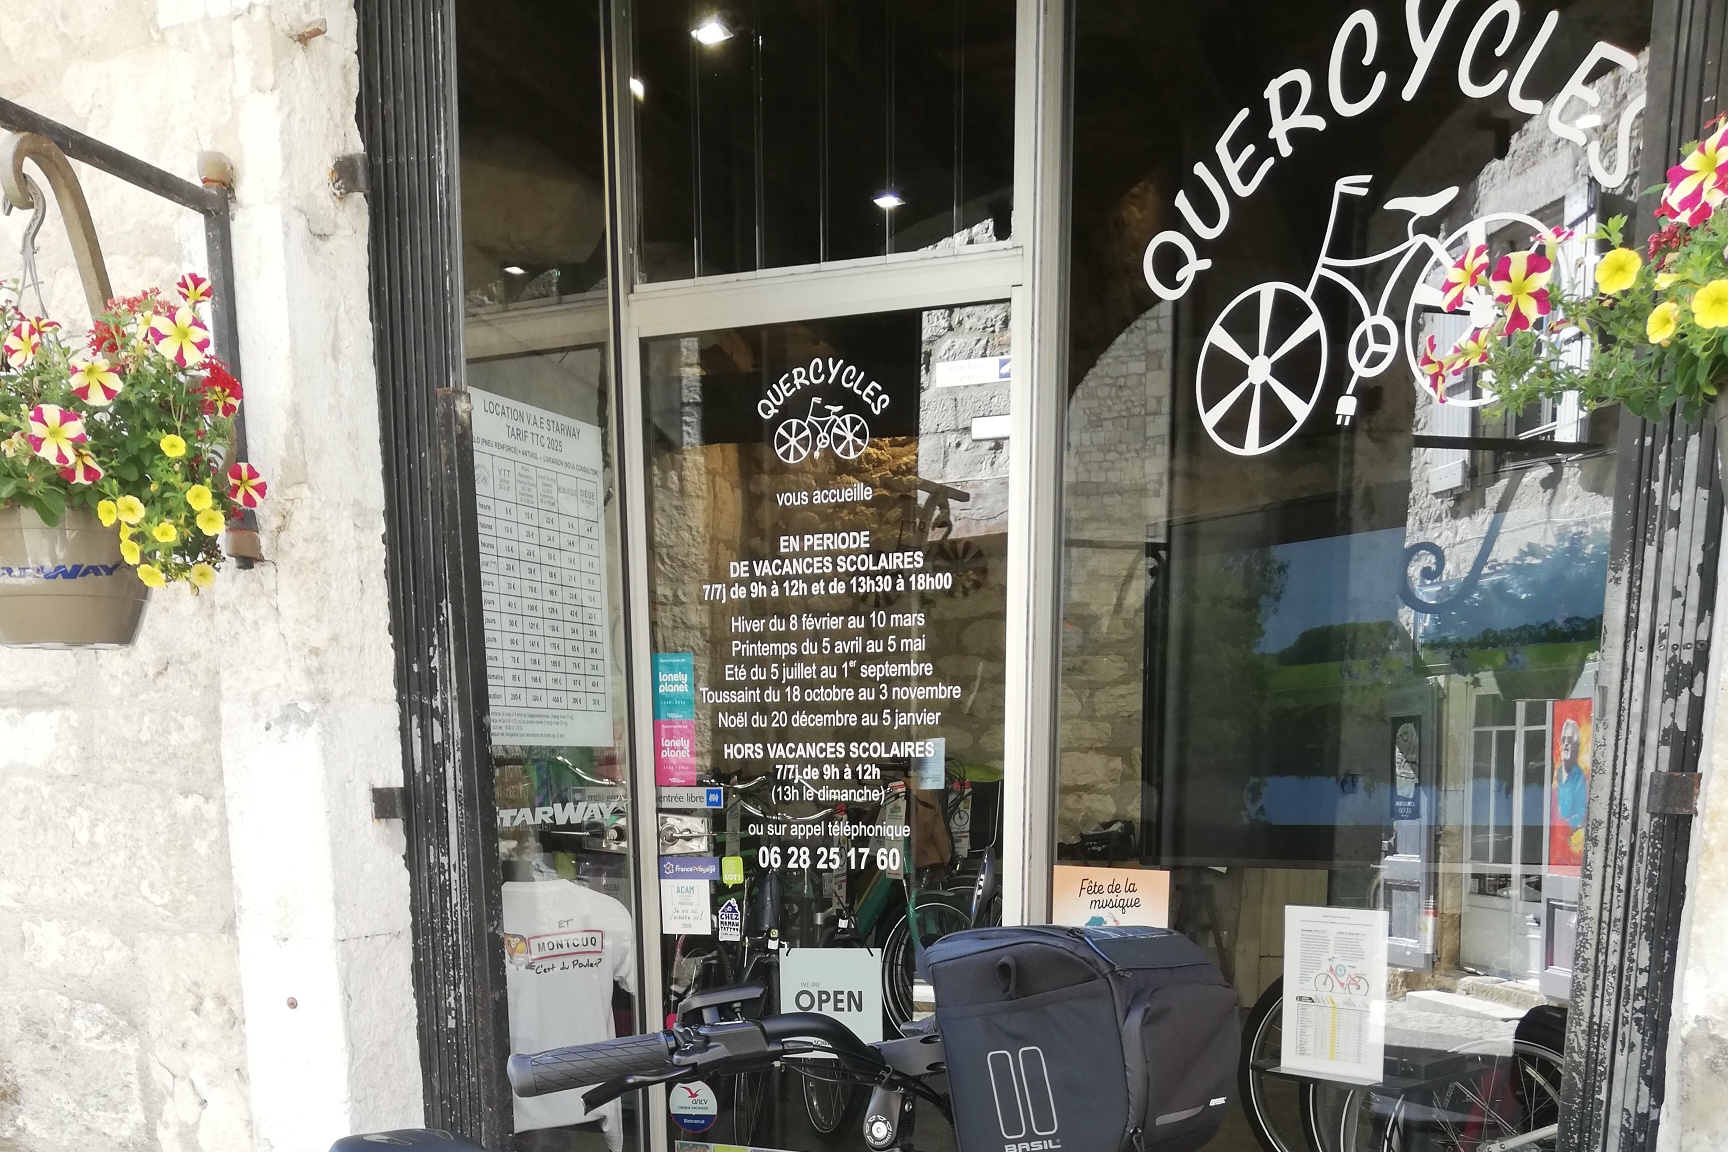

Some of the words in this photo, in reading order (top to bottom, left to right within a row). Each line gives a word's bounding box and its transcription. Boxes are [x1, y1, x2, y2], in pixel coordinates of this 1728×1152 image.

[1143, 0, 1647, 300] QUERCYCLES
[757, 357, 889, 420] QUERCYCLES
[483, 399, 524, 423] LOCATION
[547, 418, 581, 440] STARWAY
[506, 425, 528, 441] TARIF
[531, 431, 545, 447] TTC
[547, 437, 562, 452] 2025
[776, 491, 809, 507] vous
[813, 483, 872, 503] accueille
[780, 535, 800, 553] EN
[804, 531, 870, 551] PERIODE
[730, 561, 749, 578] DE
[753, 557, 832, 576] VACANCES
[837, 551, 924, 573] SCOLAIRES
[703, 584, 727, 604] 7/7j
[730, 582, 746, 600] de
[750, 582, 766, 598] 9h
[771, 580, 779, 597] à
[784, 580, 807, 596] 12h
[812, 581, 825, 595] et
[829, 578, 846, 594] de
[850, 577, 892, 593] 13h30
[896, 575, 905, 591] à
[909, 573, 952, 591] 18h00
[731, 616, 765, 632] Hiver
[769, 615, 785, 631] du
[789, 616, 798, 630] 8
[801, 613, 844, 629] février
[848, 616, 864, 629] au
[869, 613, 886, 628] 10
[891, 613, 925, 627] mars
[732, 640, 797, 659] Printemps
[801, 638, 817, 655] du
[822, 640, 831, 654] 5
[835, 638, 862, 653] avril
[866, 640, 883, 653] au
[888, 637, 896, 651] 5
[901, 635, 925, 651] mai
[659, 672, 687, 684] lonely
[725, 664, 746, 681] Eté
[751, 664, 767, 680] du
[771, 664, 779, 679] 5
[782, 662, 816, 681] juillet
[820, 665, 837, 678] au
[861, 660, 933, 680] septembre
[659, 683, 688, 693] planet
[700, 687, 760, 703] Toussaint
[764, 686, 780, 702] du
[785, 687, 800, 701] 18
[804, 685, 854, 701] octobre
[859, 687, 875, 700] au
[880, 685, 888, 699] 3
[892, 683, 961, 699] novembre
[719, 711, 747, 728] Noël
[752, 711, 767, 727] du
[771, 711, 787, 727] 20
[792, 709, 857, 726] décembre
[861, 712, 878, 726] au
[882, 711, 891, 725] 5
[894, 710, 941, 729] janvier
[662, 737, 689, 750] lonely
[662, 749, 690, 758] planet
[724, 744, 763, 759] HORS
[767, 743, 845, 758] VACANCES
[850, 741, 934, 758] SCOLAIRES
[775, 765, 800, 783] 7/7j
[803, 765, 819, 780] de
[823, 765, 839, 780] 9h
[844, 764, 852, 779] à
[856, 764, 880, 780] 12h
[658, 793, 684, 803] entrée
[687, 793, 704, 802] libre
[771, 786, 799, 805] (13h
[803, 786, 814, 802] le
[818, 786, 885, 804] dimanche)
[497, 802, 618, 826] TARWAY
[748, 823, 764, 836] ou
[767, 823, 786, 835] sur
[791, 821, 824, 842] appel
[828, 821, 910, 841] téléphonique
[758, 846, 781, 869] 06
[787, 846, 811, 869] 28
[817, 847, 840, 870] 25
[847, 847, 868, 870] 17
[876, 847, 900, 871] 60
[1079, 878, 1104, 897] Fête
[1108, 879, 1121, 894] de
[1125, 878, 1137, 892] la
[1090, 895, 1141, 914] musique
[558, 919, 573, 928] ET
[538, 937, 596, 952] MONTCUQ
[535, 964, 556, 974] C'est
[560, 961, 569, 970] du
[795, 990, 862, 1012] OPEN
[1209, 1097, 1226, 1106] BASIL
